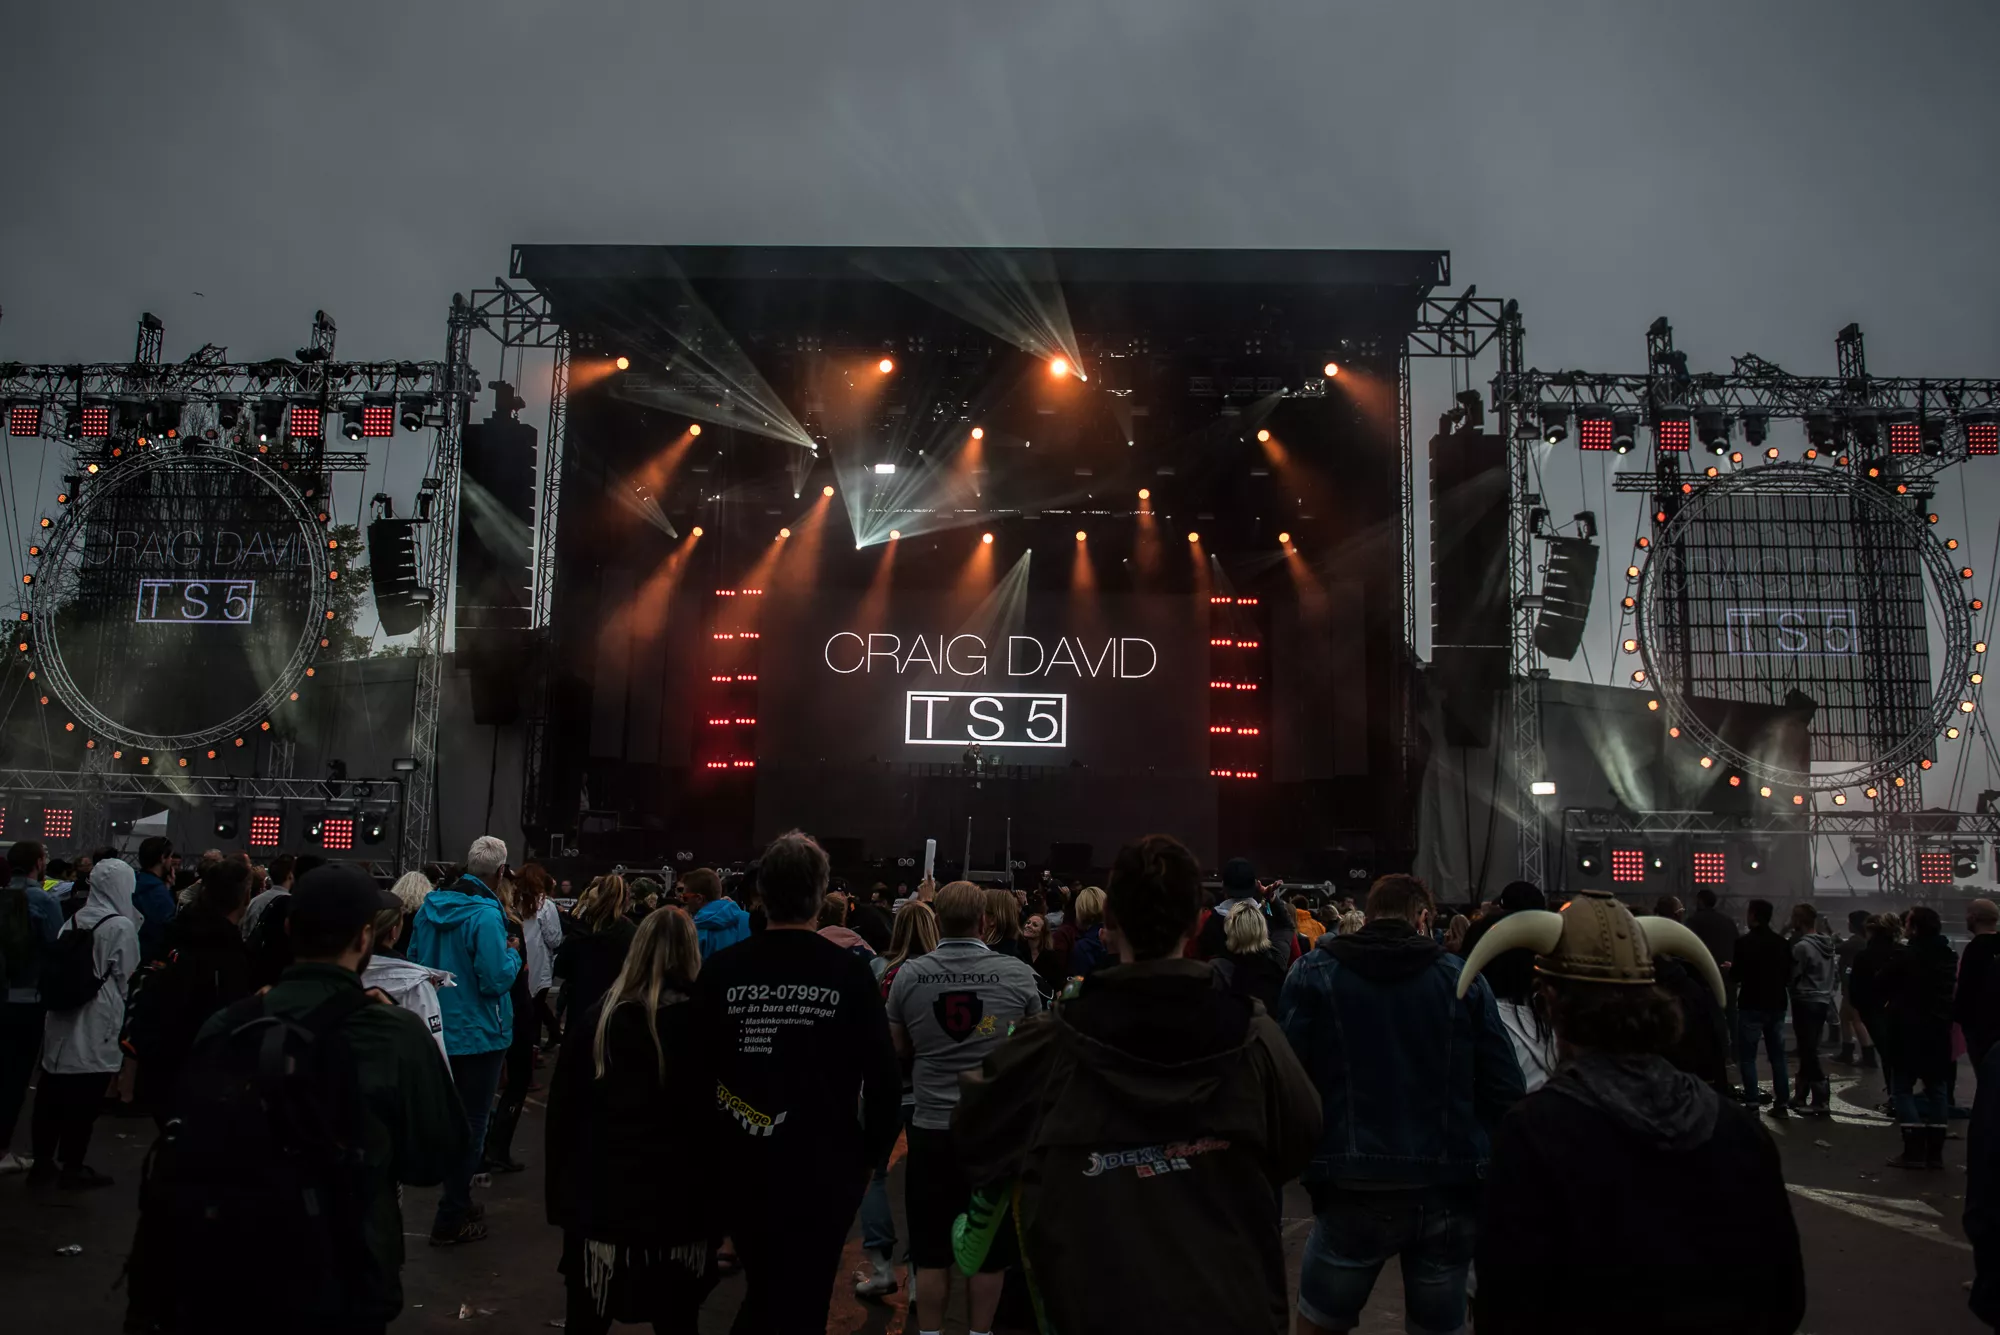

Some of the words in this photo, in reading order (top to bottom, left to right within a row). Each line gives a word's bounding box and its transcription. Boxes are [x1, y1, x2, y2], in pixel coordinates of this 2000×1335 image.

[824, 632, 987, 676] CRAIG
[1008, 636, 1157, 679] DAVID
[726, 985, 840, 1005] 0732-079970
[728, 1005, 745, 1015] Mer
[747, 1004, 760, 1013] än
[762, 1004, 784, 1012] bara
[786, 1004, 799, 1013] ett
[799, 1006, 836, 1018] garage!
[946, 995, 971, 1032] 5
[745, 1027, 778, 1035] Verkstad
